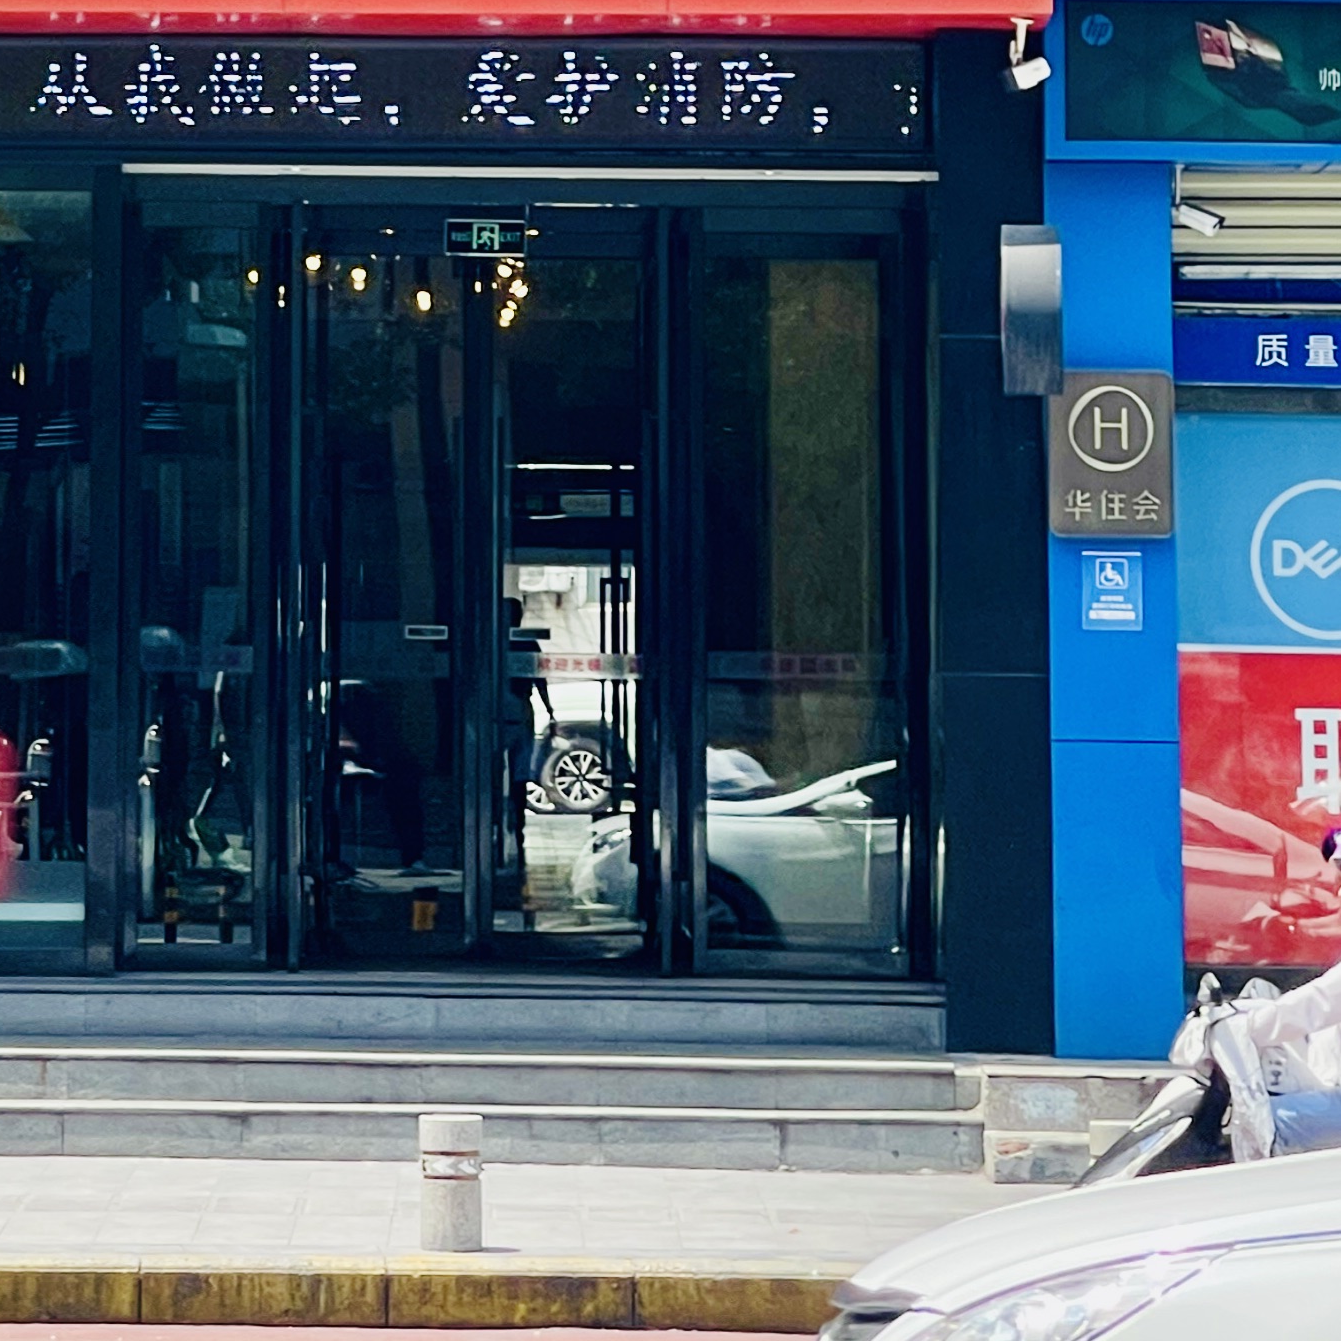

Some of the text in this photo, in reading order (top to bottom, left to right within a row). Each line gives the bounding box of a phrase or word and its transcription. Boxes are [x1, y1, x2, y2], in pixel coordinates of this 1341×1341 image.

[1256, 334, 1339, 367] 质量
[1063, 489, 1162, 521] 华住会
